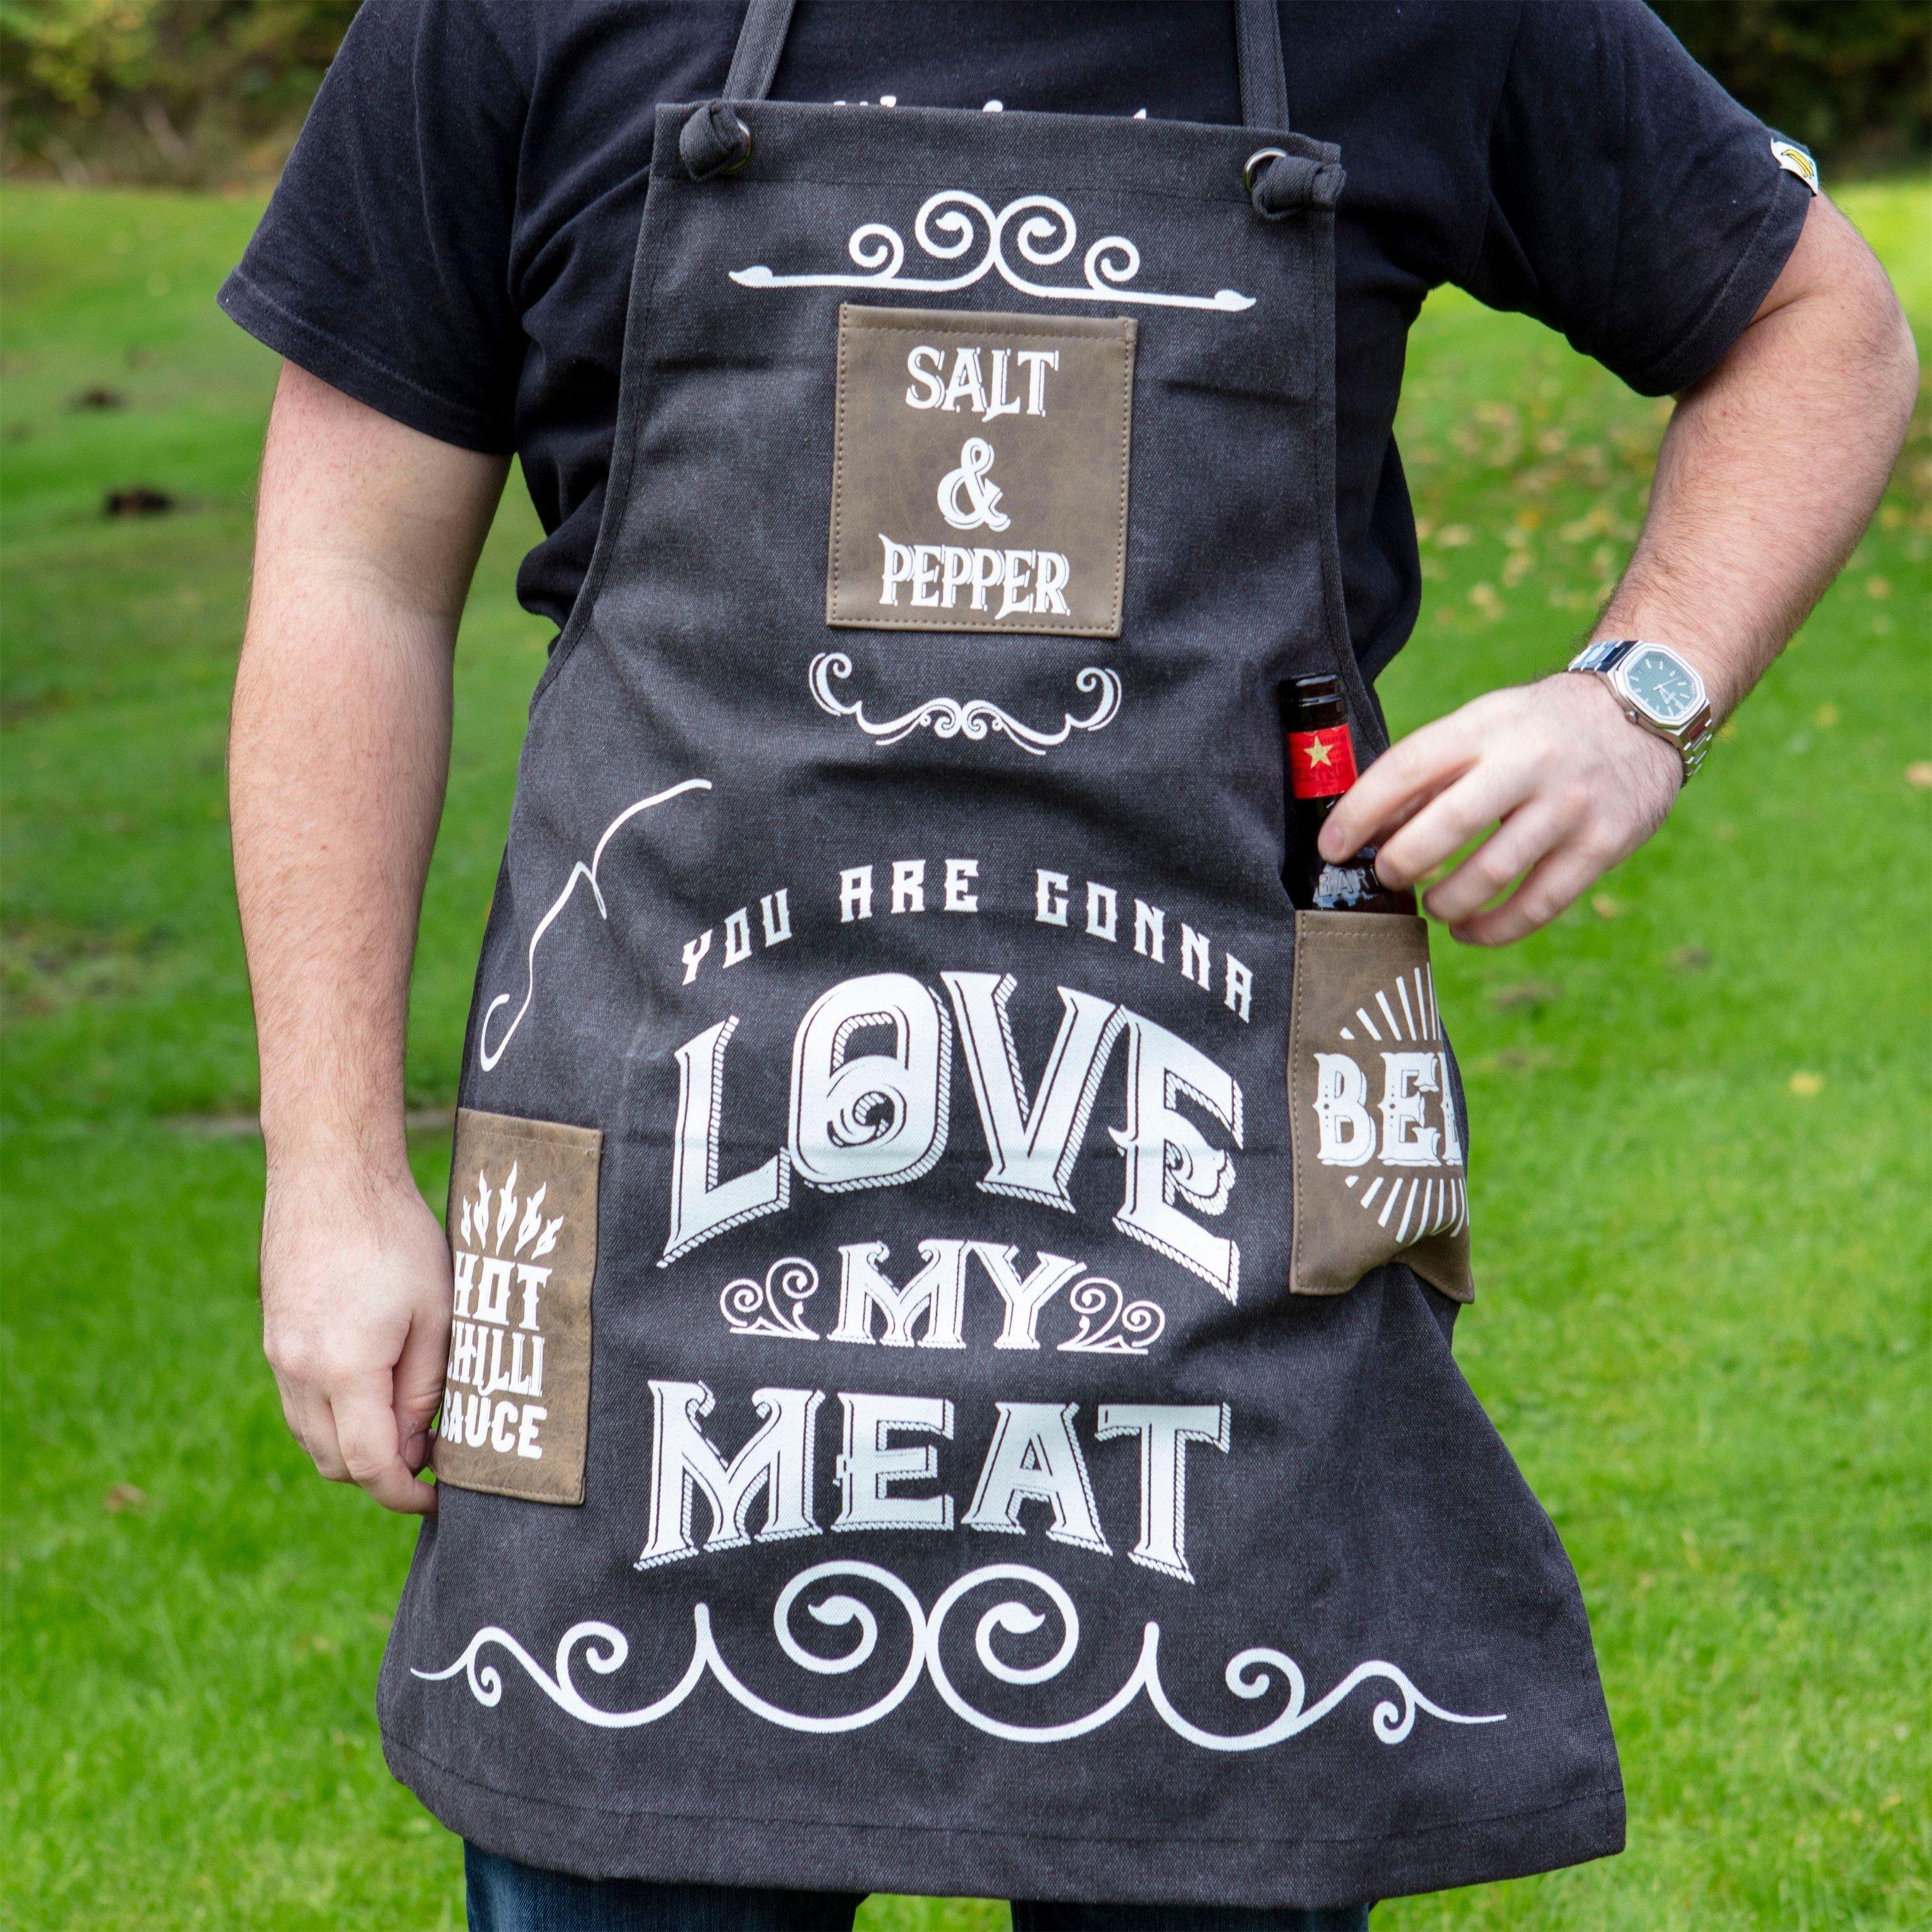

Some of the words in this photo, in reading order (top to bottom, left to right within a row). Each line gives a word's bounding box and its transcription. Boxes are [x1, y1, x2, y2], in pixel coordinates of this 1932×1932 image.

[905, 345, 1059, 422] SALT
[937, 437, 1011, 532] &
[878, 533, 1071, 620] PEPPER
[682, 888, 791, 985] YOU
[839, 858, 979, 922] ARE
[1035, 868, 1253, 1023] GONNA
[656, 971, 1244, 1304] LOVE
[453, 1251, 553, 1331] HOT
[826, 1239, 1087, 1350] MY
[440, 1387, 548, 1460] SAUCE
[633, 1379, 1231, 1584] MEAT
